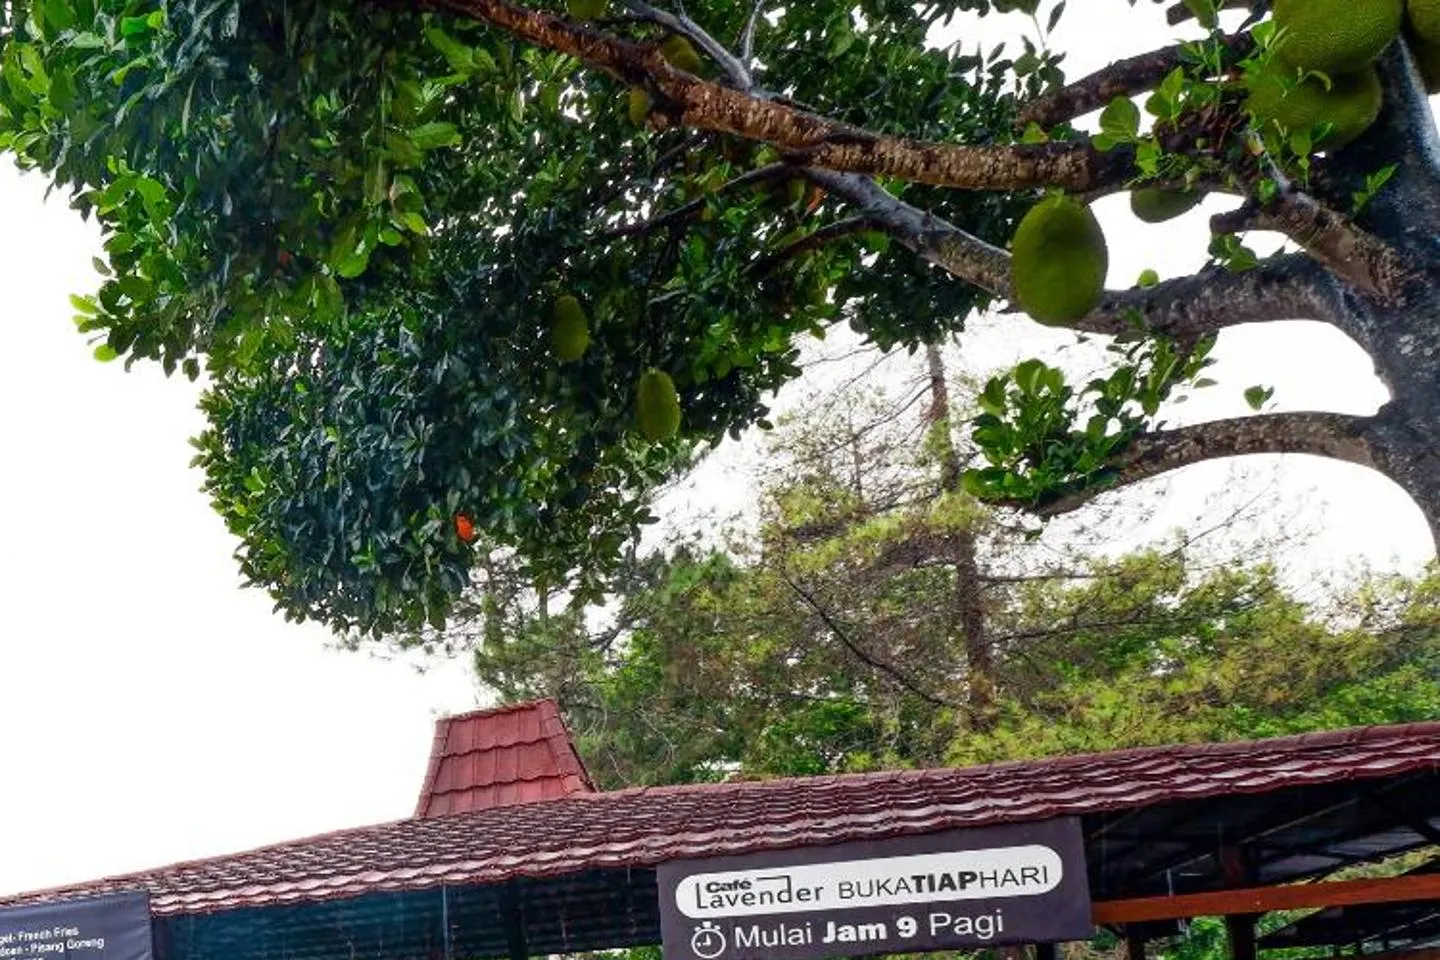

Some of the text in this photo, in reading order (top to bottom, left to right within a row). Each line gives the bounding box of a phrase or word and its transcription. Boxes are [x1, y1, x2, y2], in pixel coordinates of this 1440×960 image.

[696, 875, 824, 909] Lavender
[706, 878, 752, 893] Café
[18, 929, 52, 942] French
[53, 926, 79, 938] Fries
[735, 909, 1003, 949] Mulai Jam 9 Pagi
